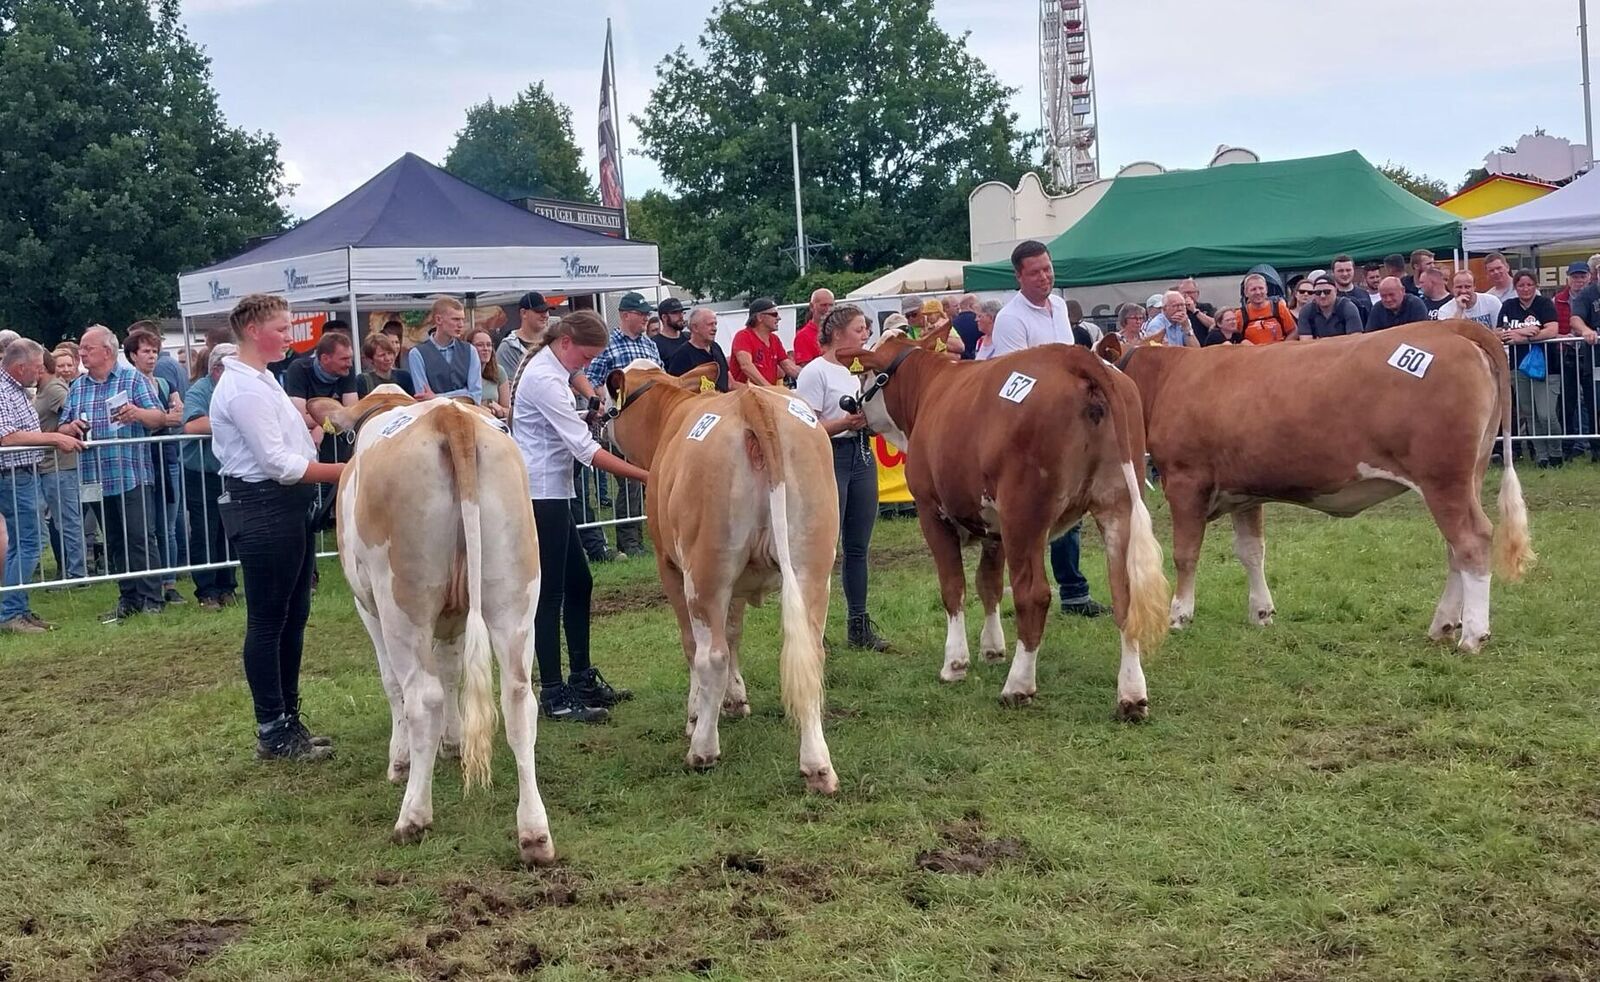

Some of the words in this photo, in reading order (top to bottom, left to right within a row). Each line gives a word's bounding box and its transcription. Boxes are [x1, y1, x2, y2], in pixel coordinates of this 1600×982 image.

[577, 212, 621, 227] REIFENRATH
[436, 267, 460, 276] RUW
[578, 265, 600, 274] RUW
[1396, 348, 1426, 373] 60
[1006, 375, 1032, 399] 57
[691, 415, 717, 438] 59
